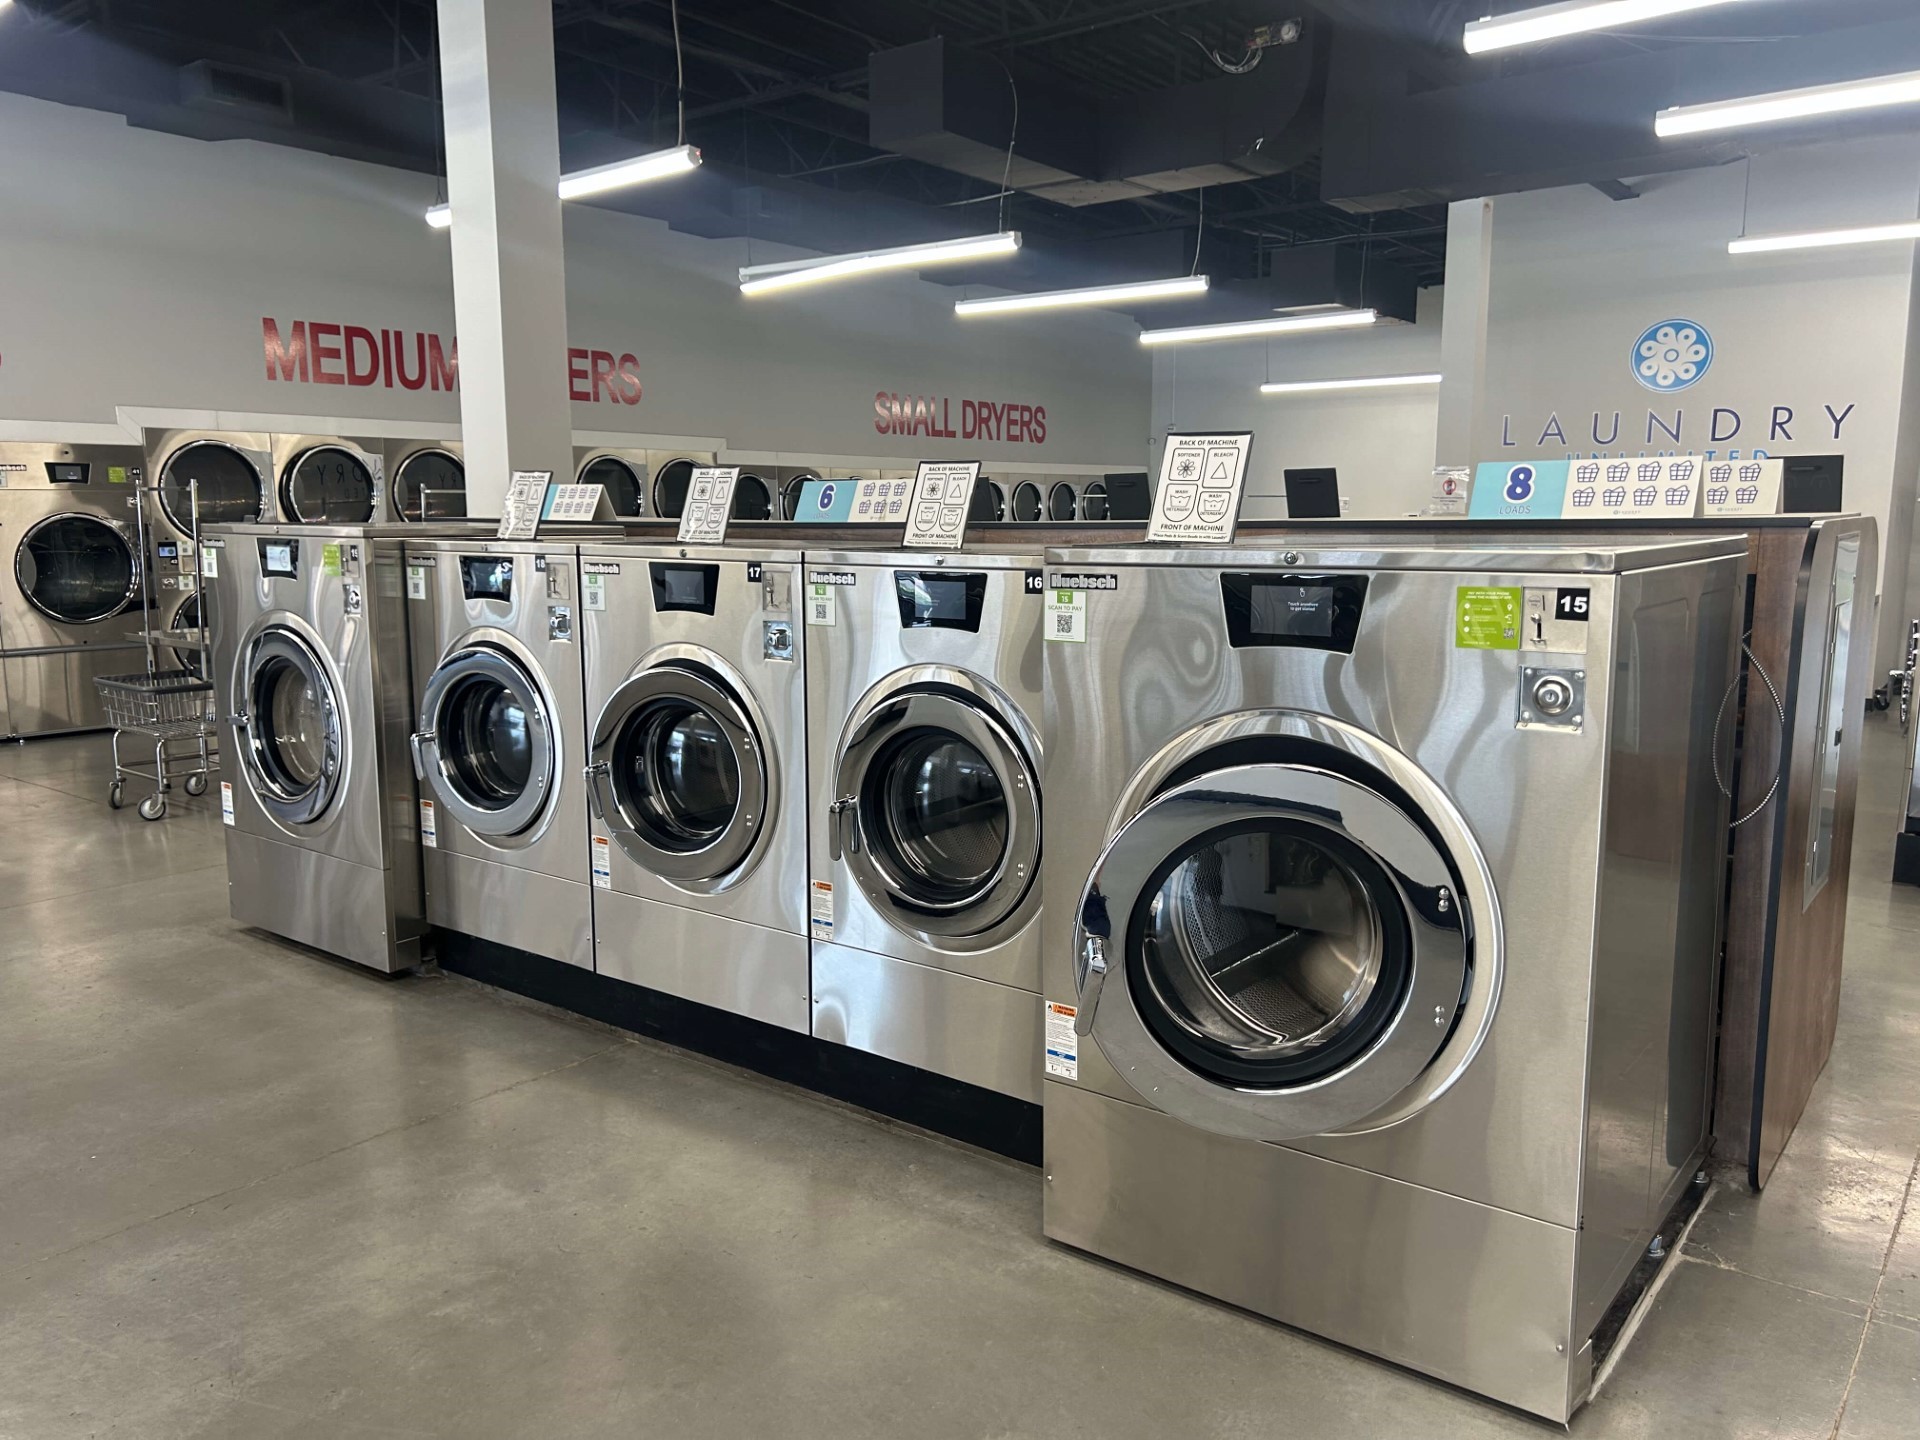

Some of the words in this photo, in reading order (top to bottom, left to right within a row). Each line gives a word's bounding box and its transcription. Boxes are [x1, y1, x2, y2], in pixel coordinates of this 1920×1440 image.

[262, 317, 460, 391] MEDIUM
[567, 347, 642, 405] ERS
[874, 391, 956, 438] SMALL
[962, 399, 1046, 444] DRYERS
[1502, 404, 1855, 447] LAUNDRY
[1505, 465, 1534, 502] 8
[819, 484, 835, 509] 6
[1499, 505, 1532, 515] LOADS
[535, 559, 546, 569] 18
[584, 563, 619, 573] Huebsch
[748, 567, 761, 578] 17
[810, 571, 855, 585] Huebsch
[1026, 577, 1043, 589] 16
[1051, 574, 1116, 589] Huebsch
[1560, 596, 1588, 613] 15
